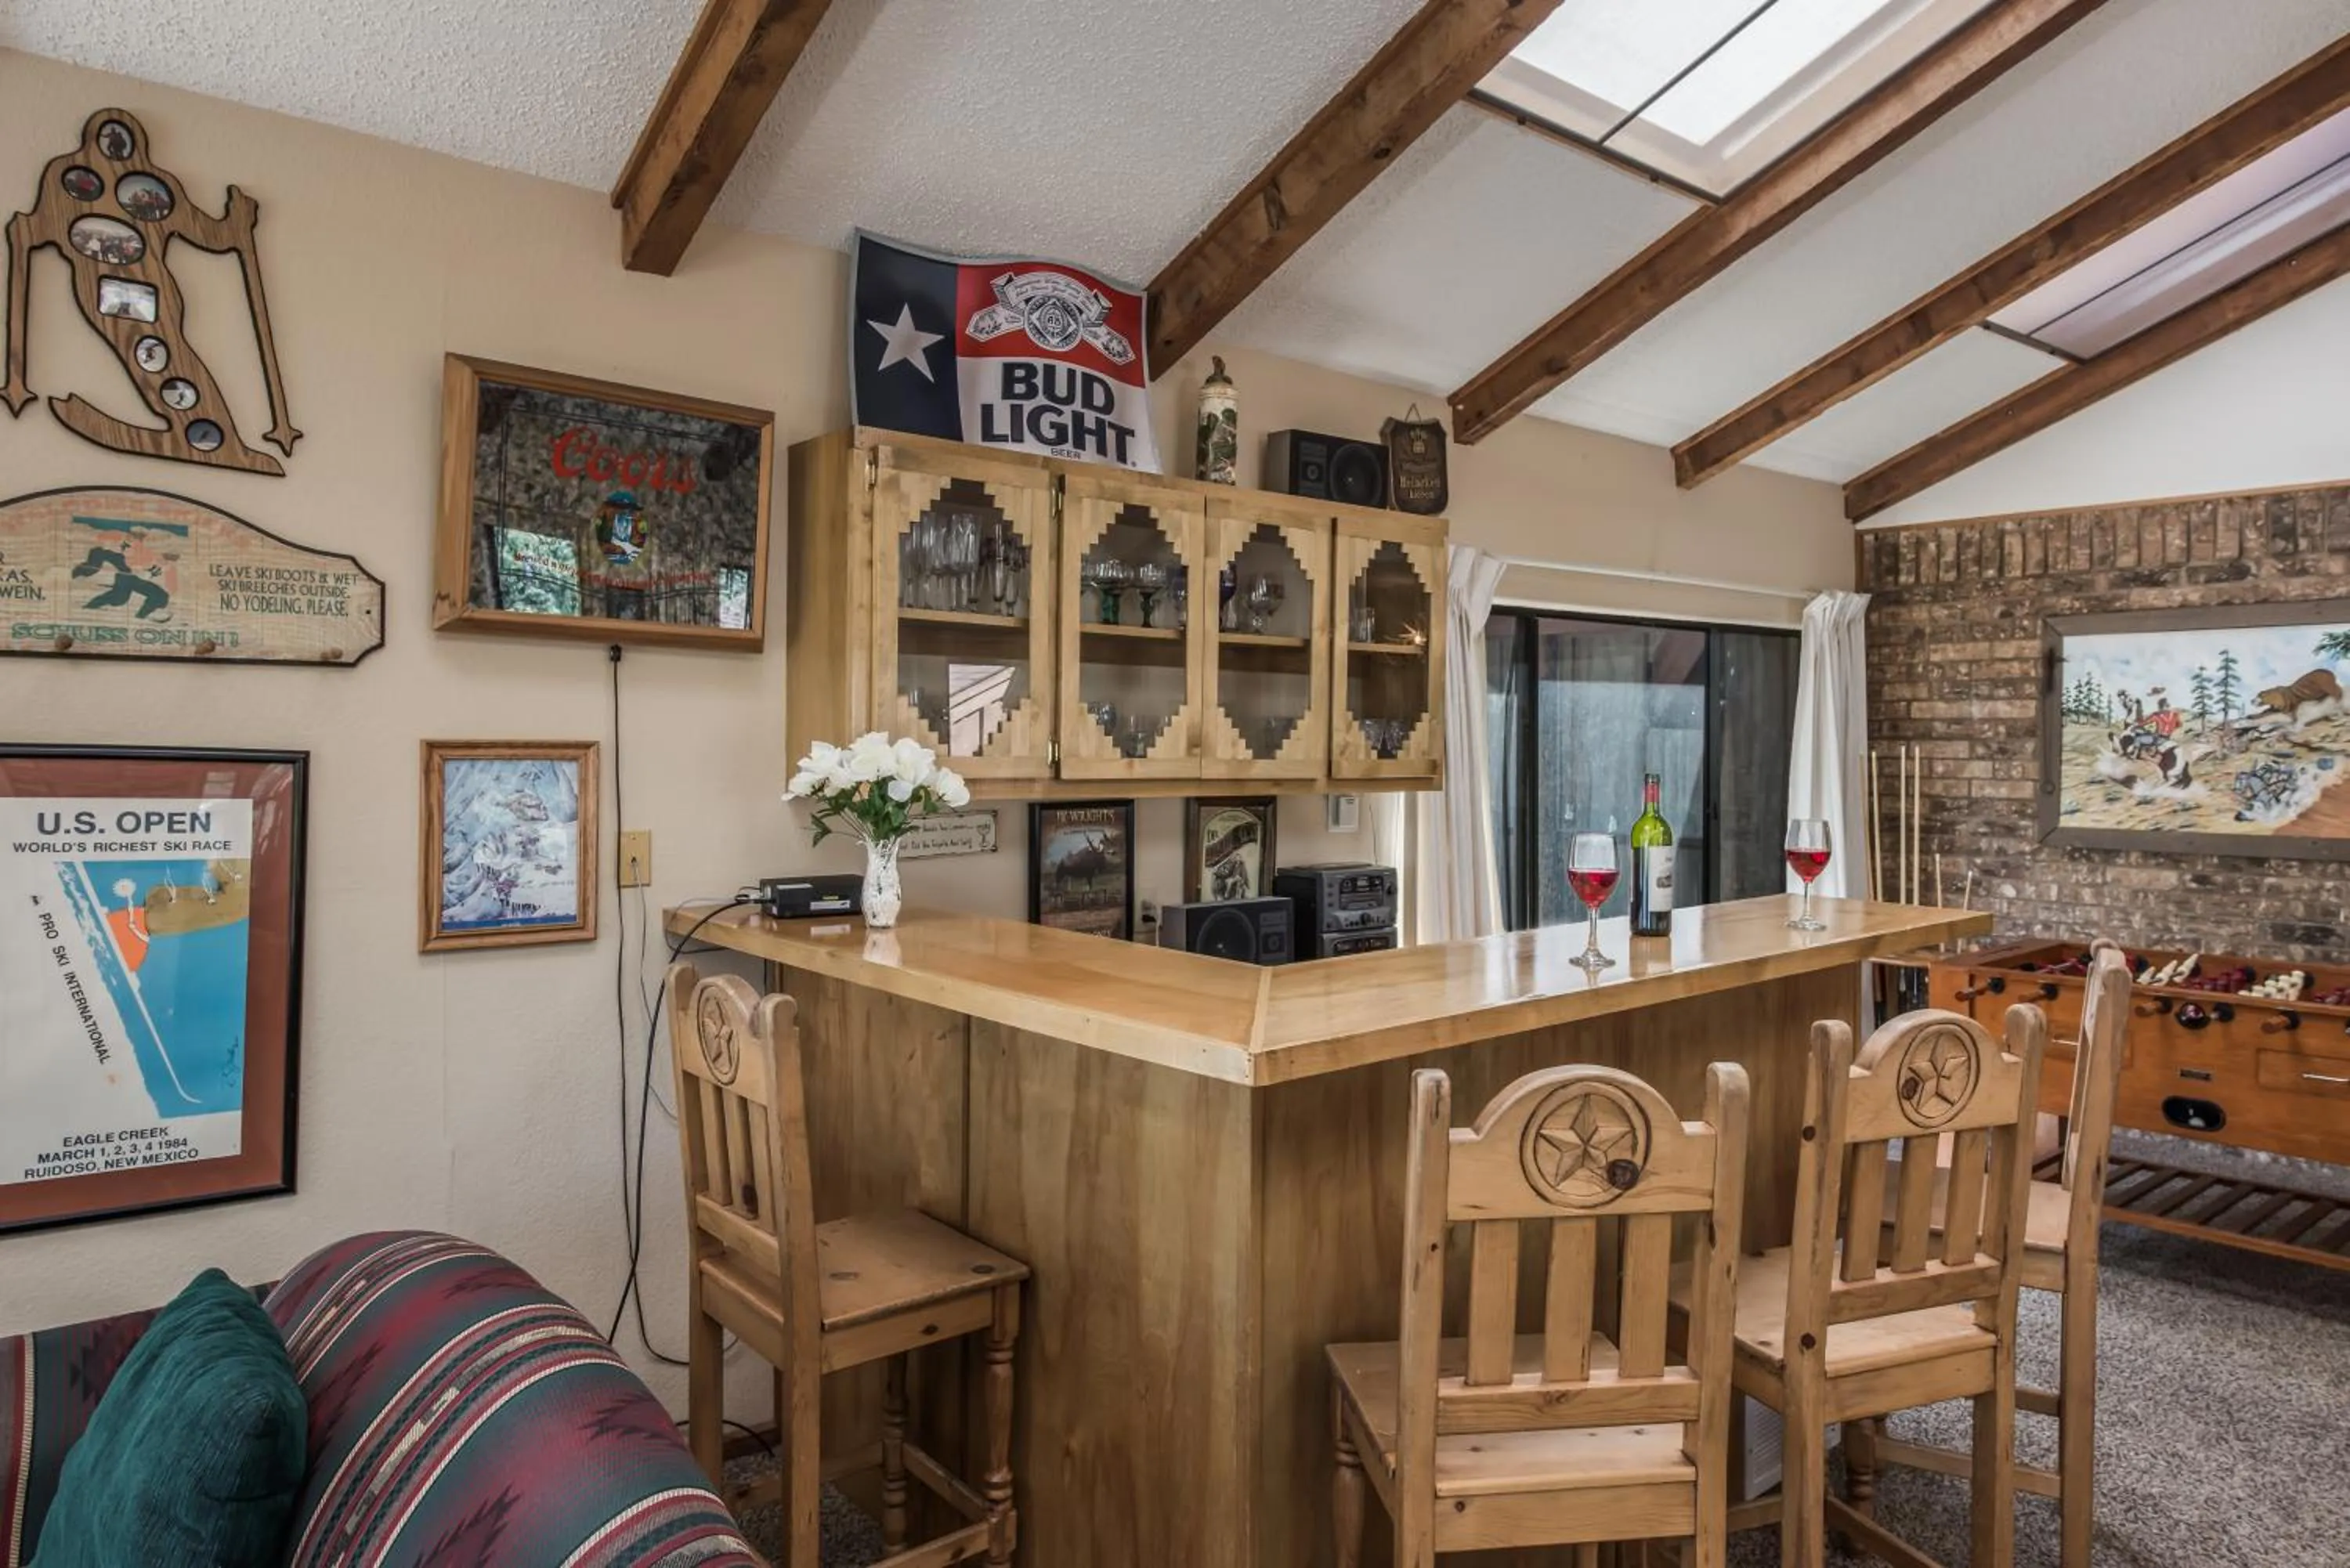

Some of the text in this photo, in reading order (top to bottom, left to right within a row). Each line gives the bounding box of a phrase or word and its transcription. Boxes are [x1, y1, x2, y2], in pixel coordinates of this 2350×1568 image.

[1001, 362, 1115, 416] BUD
[981, 403, 1135, 464] LIGHT
[551, 425, 697, 495] Coors
[1050, 447, 1082, 460] BEER
[209, 563, 251, 578] LEAVE
[255, 567, 273, 580] SKI
[275, 569, 316, 583] BOOTS
[333, 573, 360, 586] WET
[218, 579, 236, 591] SKI
[239, 580, 297, 596] BREECHES
[220, 593, 240, 612] NO
[135, 627, 186, 645] ON
[37, 811, 212, 836] U.S. OPEN
[13, 840, 233, 853] WORLD'S RICHEST SKI RACE
[39, 912, 111, 1065] PRO SKI INTERNATIONAL
[63, 1126, 169, 1147] EAGLE CREEK
[38, 1147, 95, 1164] MARCH
[145, 1141, 153, 1151] 4
[157, 1138, 188, 1151] 1984
[103, 1155, 139, 1169] NEW
[142, 1148, 199, 1165] MEXICO
